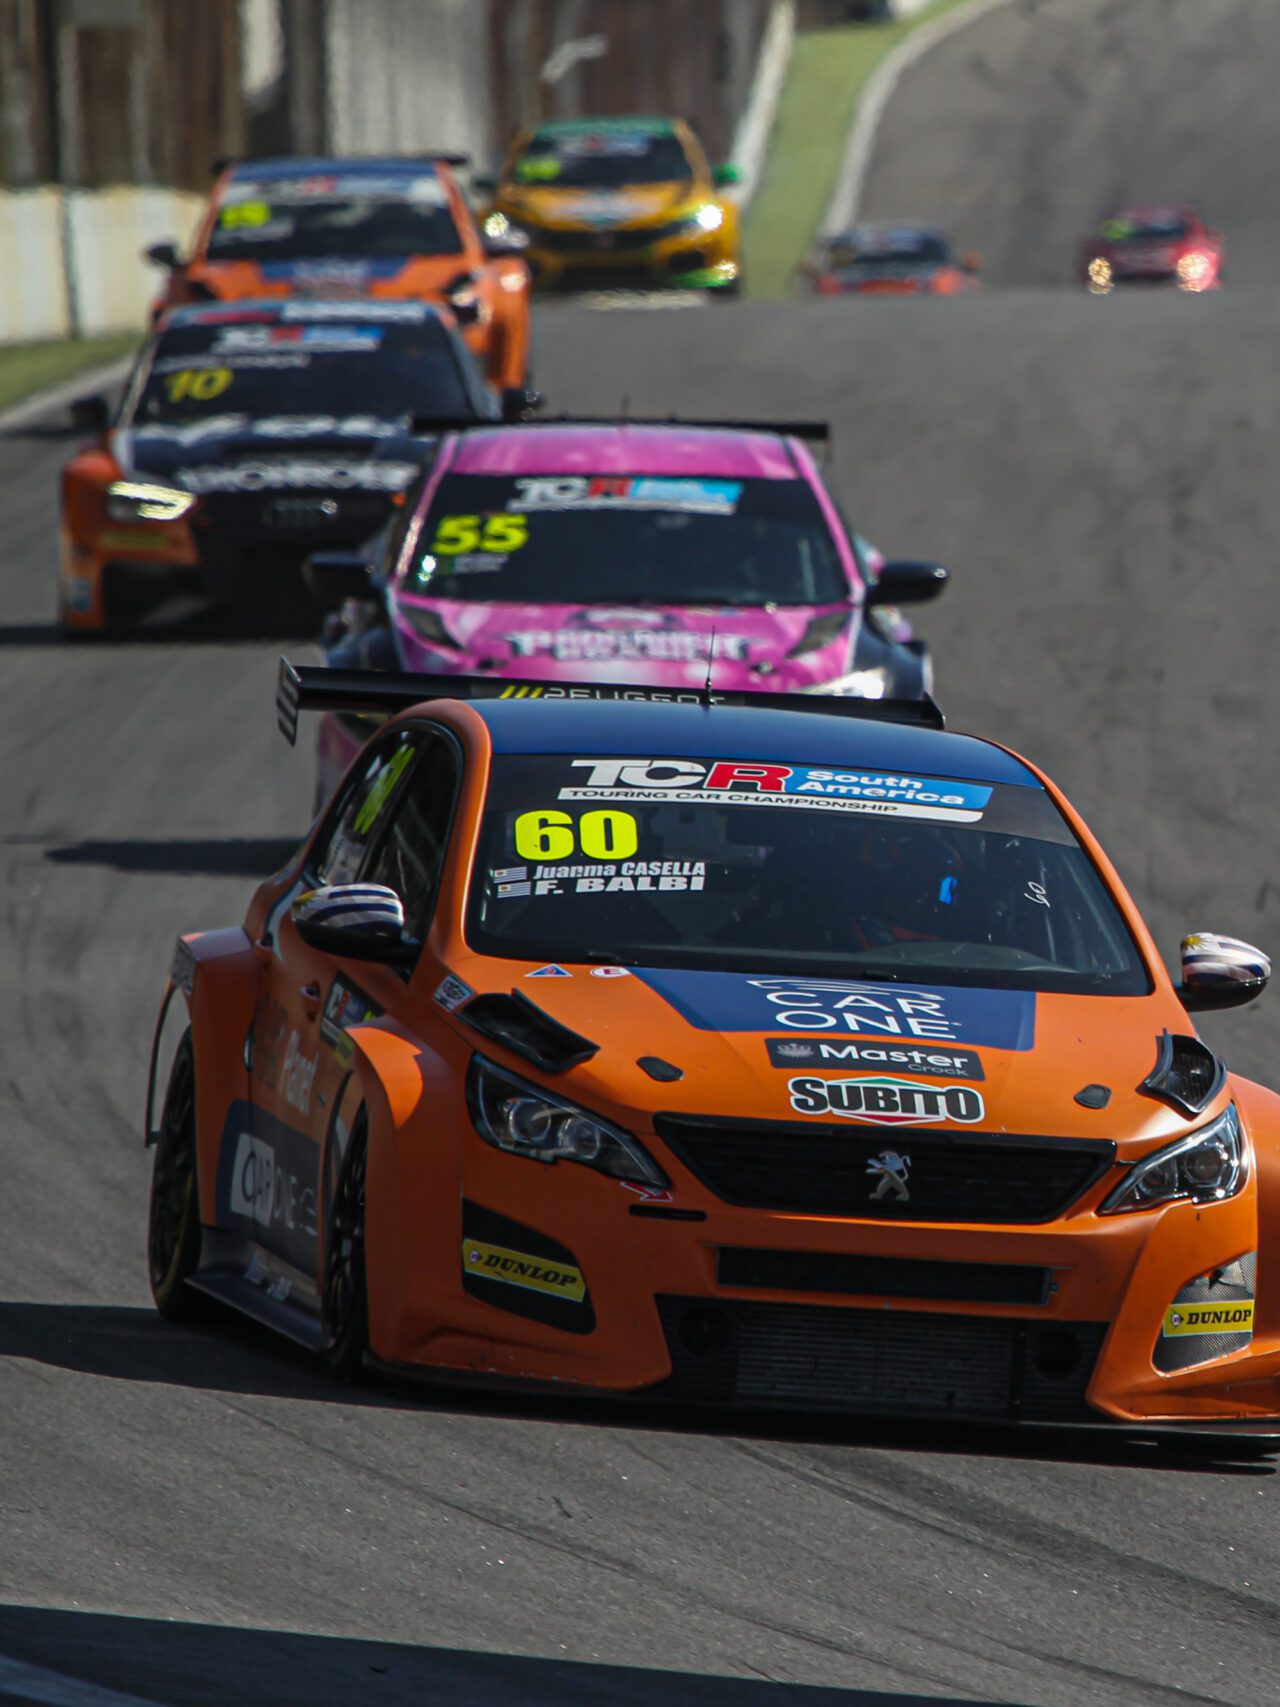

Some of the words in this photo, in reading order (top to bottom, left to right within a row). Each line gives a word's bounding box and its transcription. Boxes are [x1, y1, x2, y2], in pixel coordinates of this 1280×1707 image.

[165, 368, 233, 403] 10
[431, 513, 530, 554] 55
[571, 759, 794, 793] TCR
[805, 769, 923, 790] South
[569, 789, 669, 799] TOURING
[680, 792, 721, 801] CAR
[728, 793, 899, 813] CHAMPIONSHIP
[797, 780, 965, 805] America
[514, 809, 639, 861] 60
[620, 861, 706, 877] CASELLA
[534, 879, 564, 896] F.
[575, 876, 705, 893] BALBI
[766, 990, 946, 1018] CAR
[775, 1010, 957, 1040] ONE
[819, 1043, 969, 1069] Master
[907, 1063, 970, 1077] Crock
[789, 1077, 985, 1123] SUBITO
[483, 1253, 578, 1287] DUNLOP
[1186, 1309, 1252, 1325] DUNLOP
